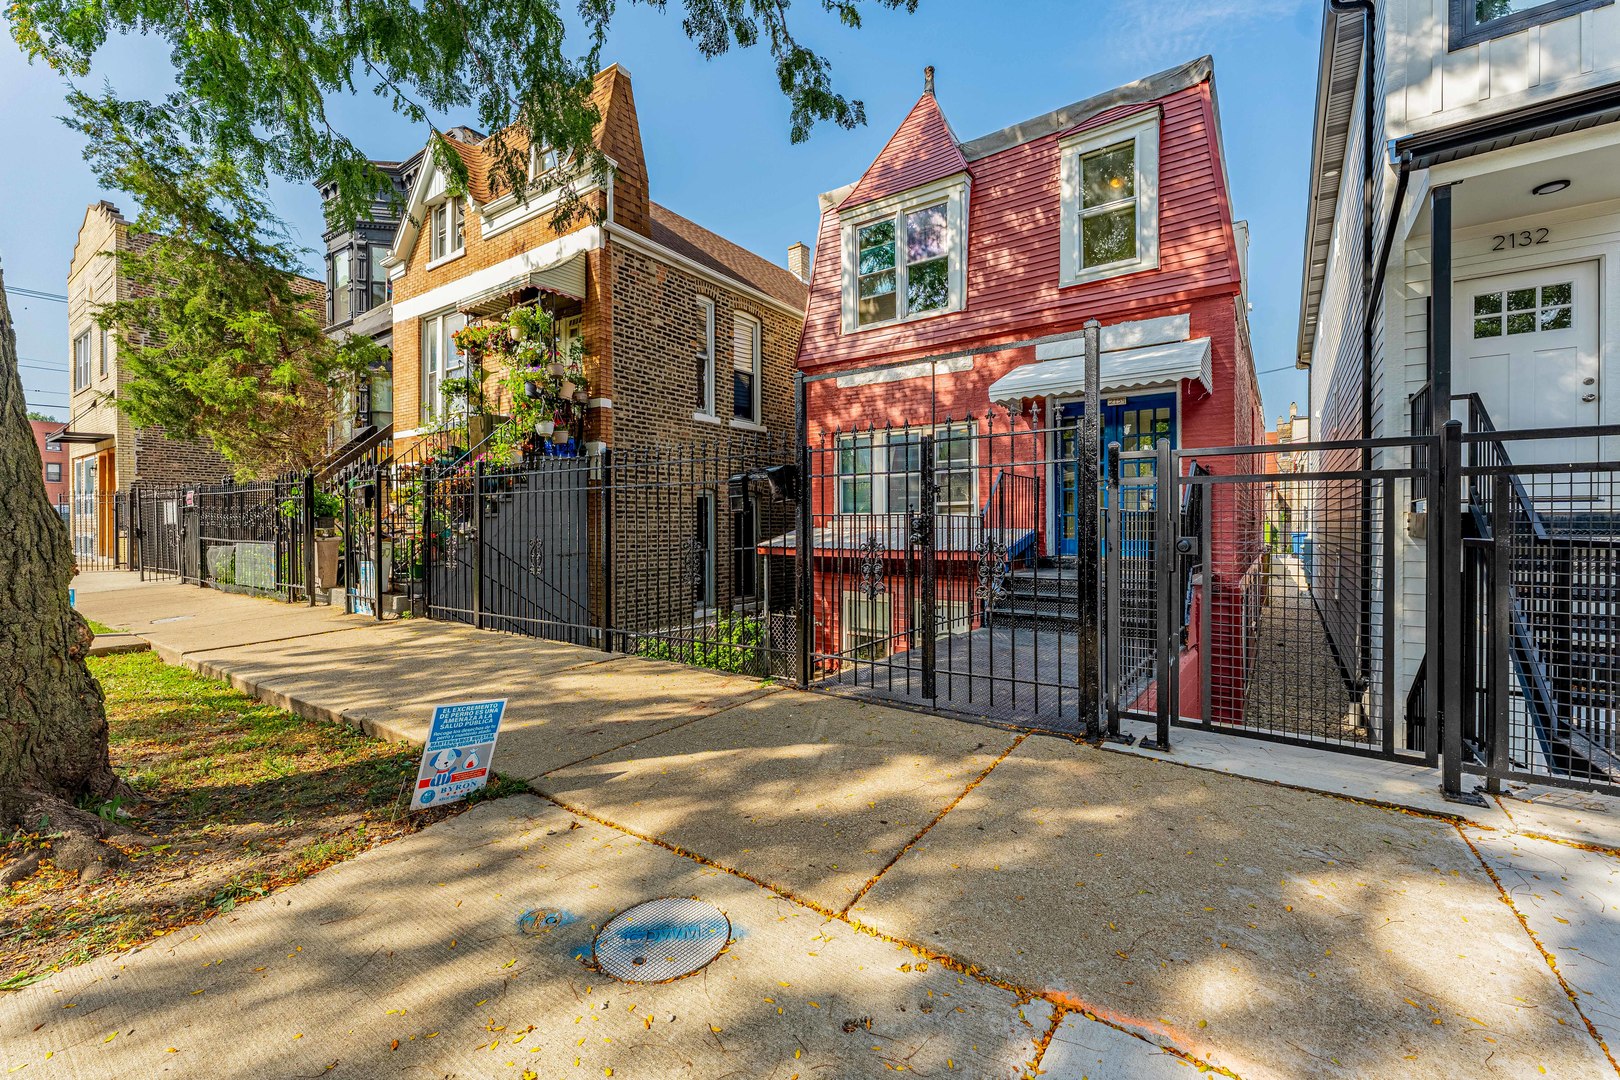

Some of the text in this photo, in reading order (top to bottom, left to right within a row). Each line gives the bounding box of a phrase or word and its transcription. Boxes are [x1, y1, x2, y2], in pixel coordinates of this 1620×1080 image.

[1492, 227, 1549, 251] 2132
[452, 703, 498, 712] EXCREMENTO
[443, 716, 477, 724] AMENAZA
[440, 722, 464, 730] SALUD
[440, 781, 477, 793] BYRON
